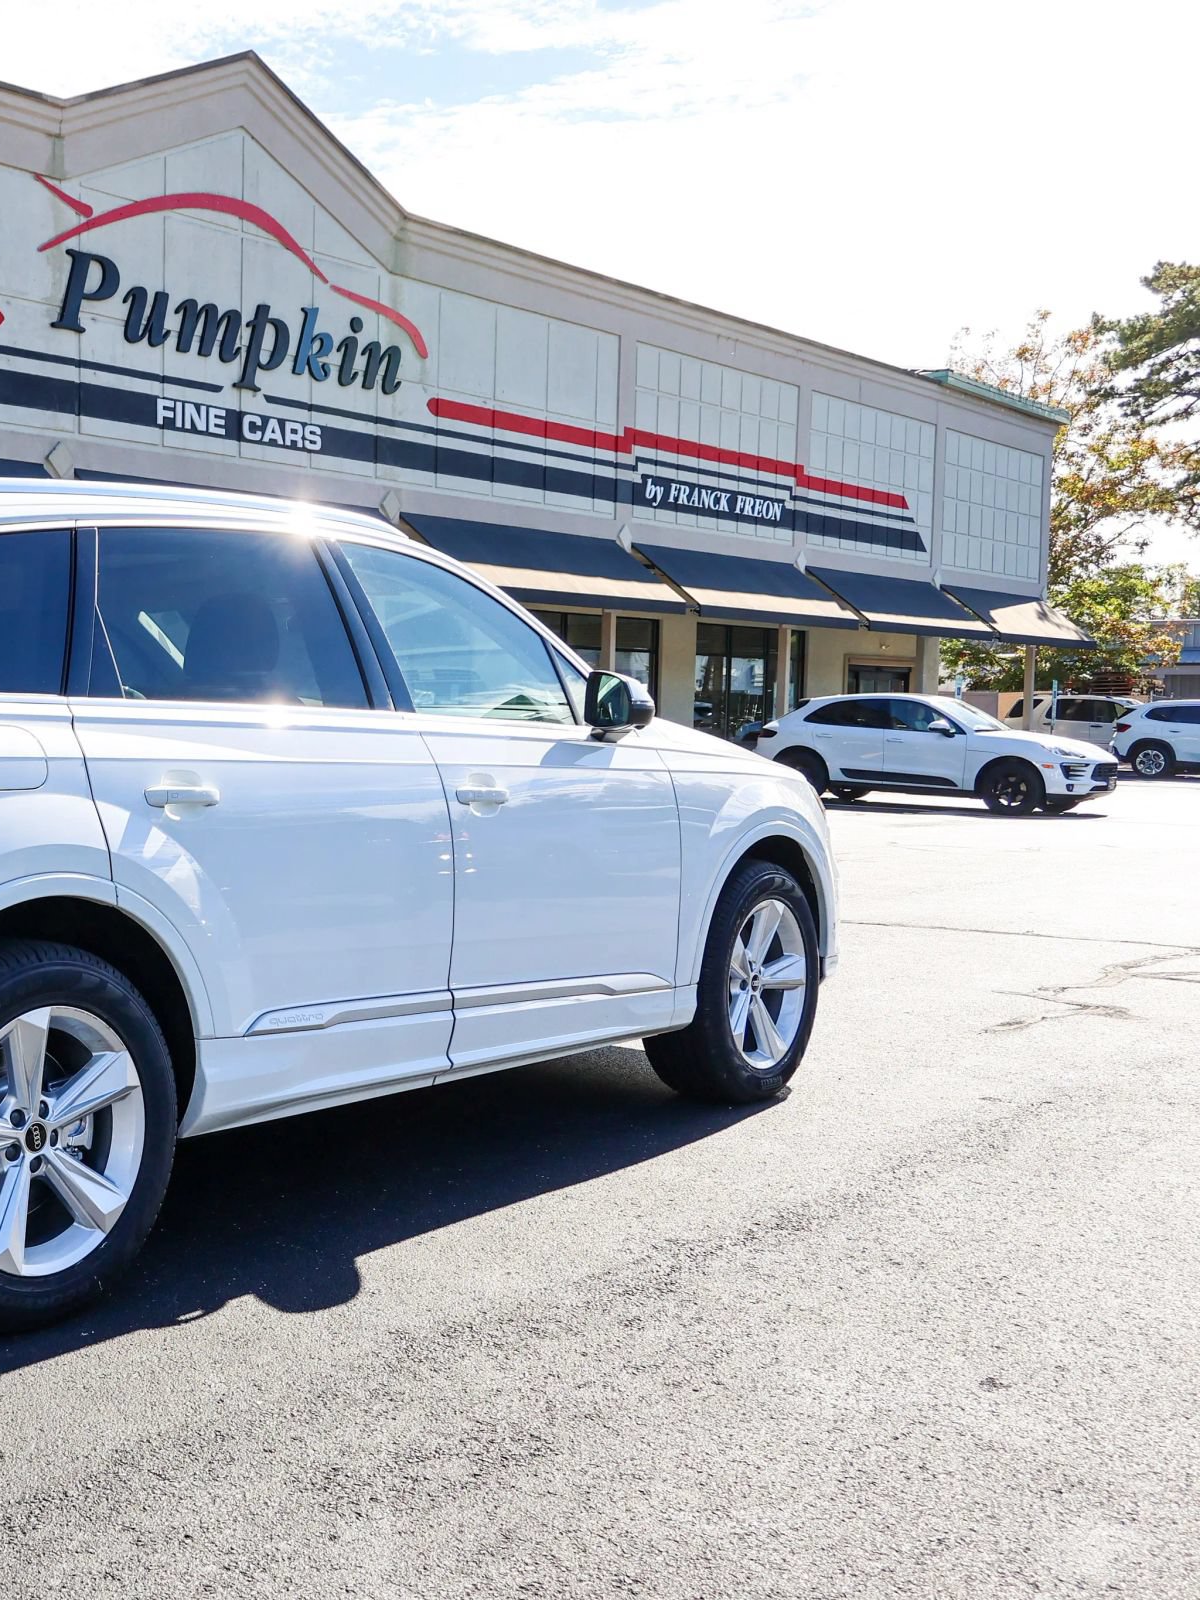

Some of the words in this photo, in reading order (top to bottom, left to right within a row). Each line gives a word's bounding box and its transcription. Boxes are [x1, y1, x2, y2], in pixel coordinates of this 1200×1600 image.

[51, 248, 402, 395] Pumpkin
[155, 398, 227, 436] FINE
[242, 413, 322, 451] CARS
[645, 478, 664, 507] by
[668, 482, 731, 513] FRANCK
[734, 495, 783, 522] FREON
[269, 1012, 324, 1027] quattro
